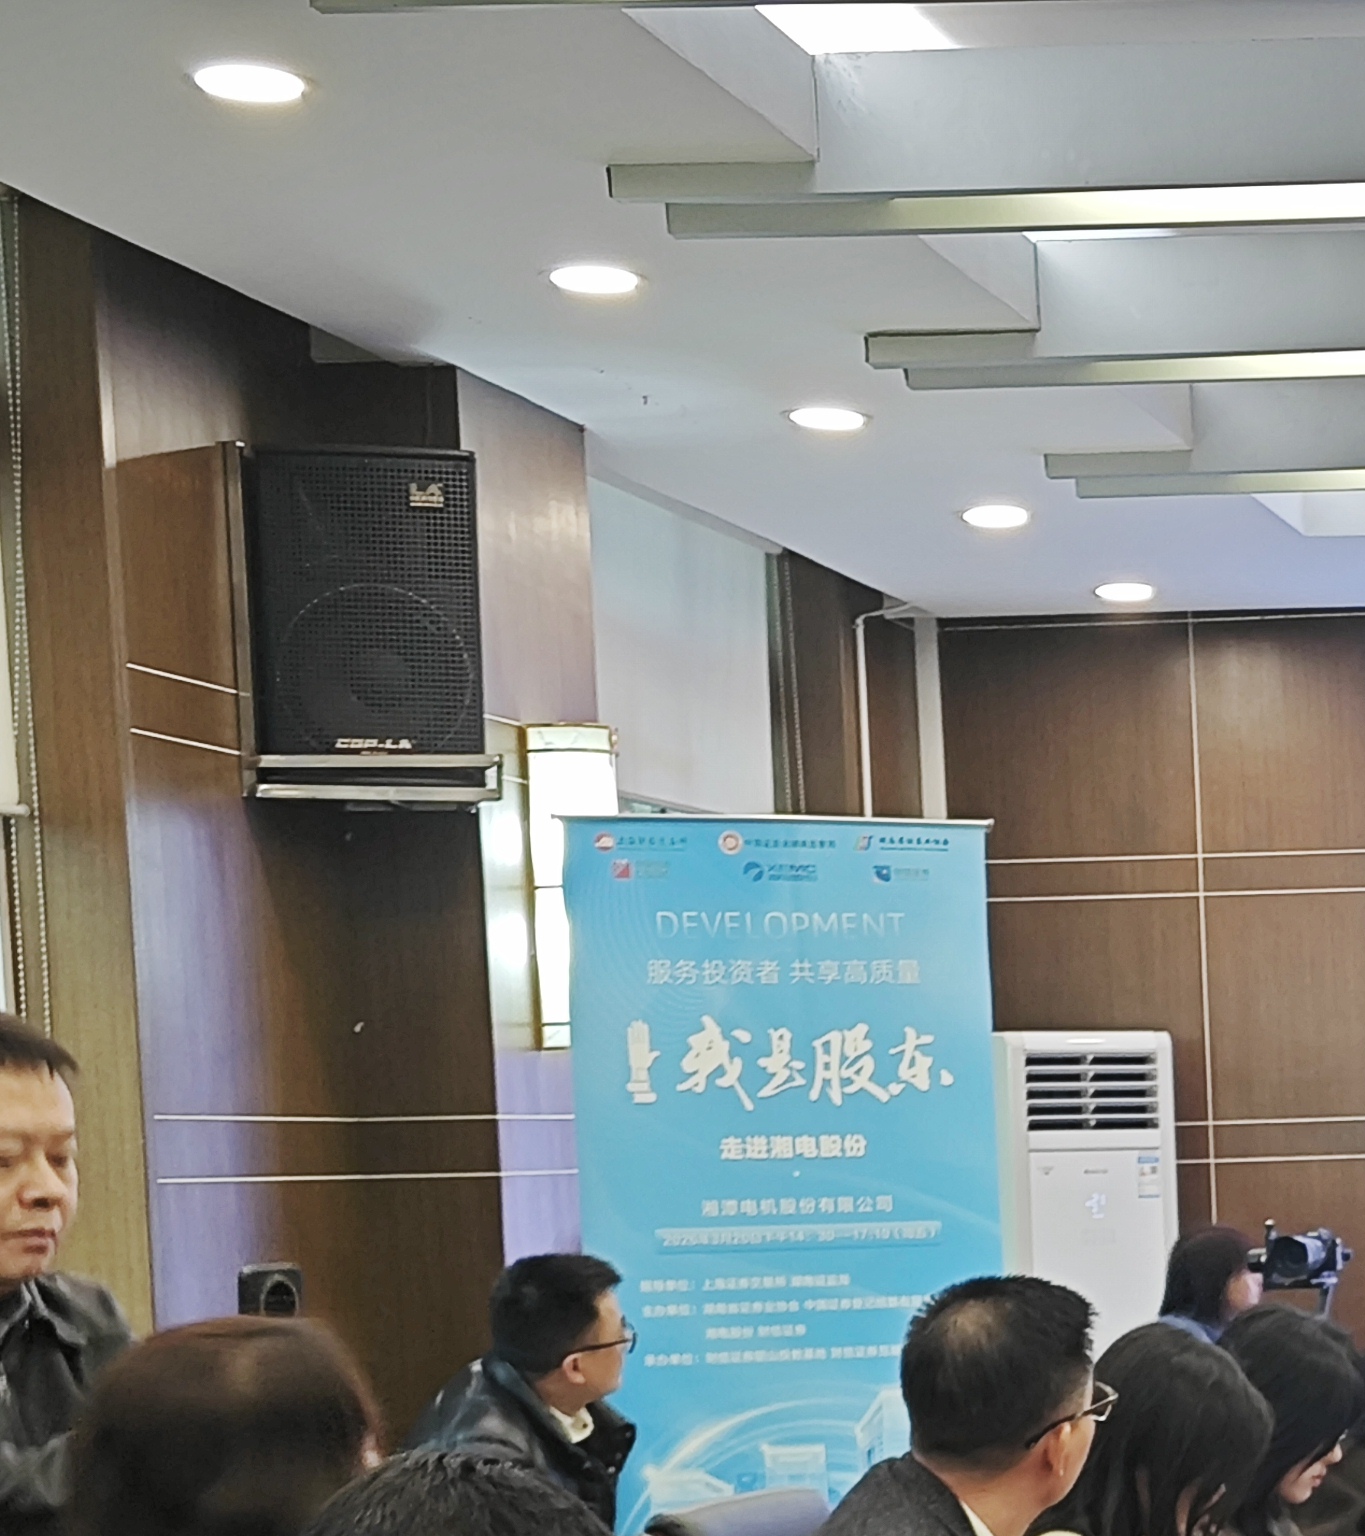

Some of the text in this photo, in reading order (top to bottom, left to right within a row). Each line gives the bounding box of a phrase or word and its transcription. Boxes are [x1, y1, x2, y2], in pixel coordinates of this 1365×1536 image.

[655, 911, 906, 939] DEVELOPMENT
[646, 958, 922, 986] 服务投资者 共享高质量
[719, 1134, 867, 1160] 走进湘电股份
